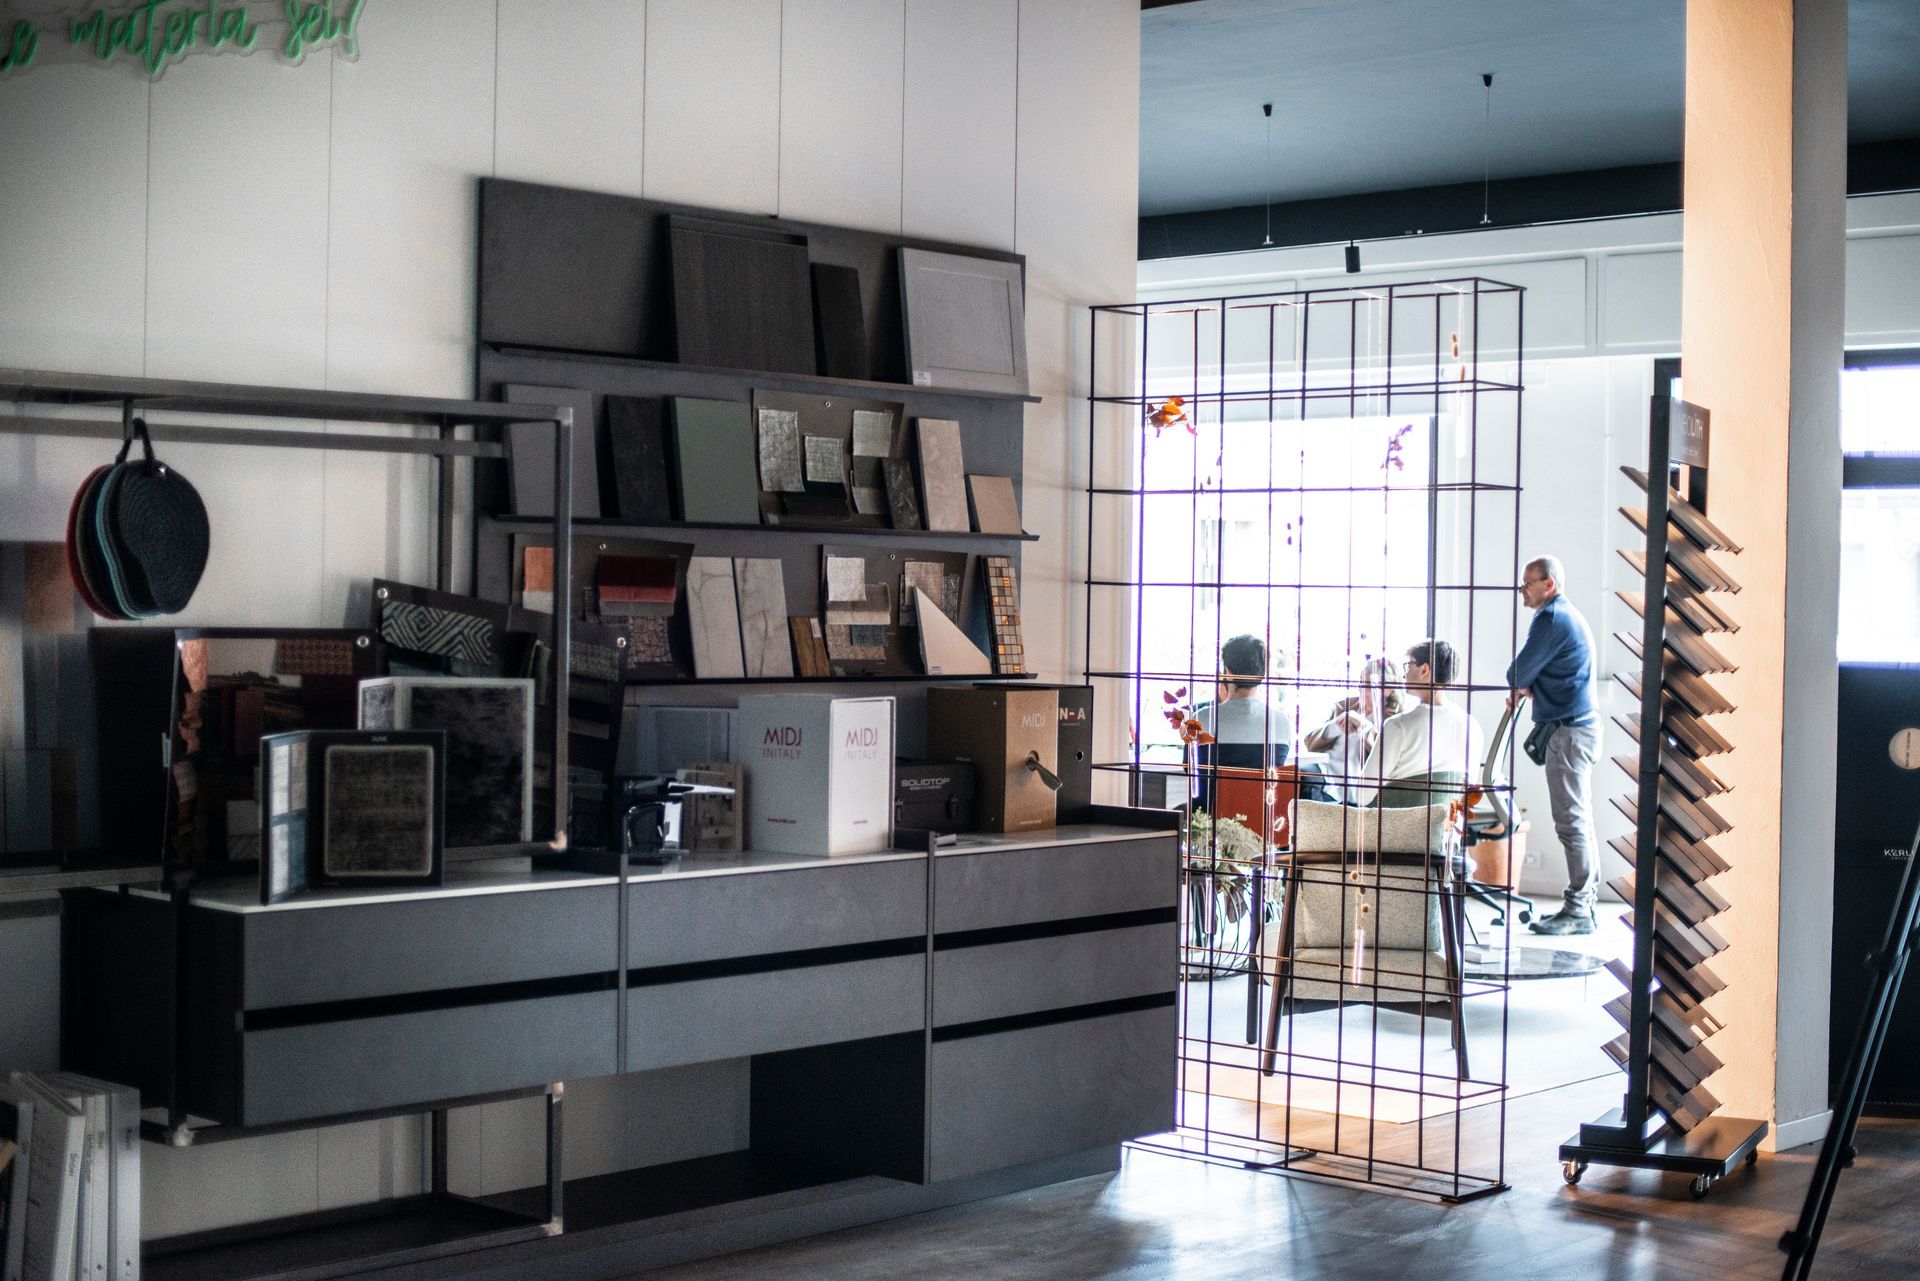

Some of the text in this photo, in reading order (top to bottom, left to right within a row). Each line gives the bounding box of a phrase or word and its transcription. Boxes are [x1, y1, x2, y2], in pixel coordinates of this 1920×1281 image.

[1021, 711, 1047, 728] MIDJ
[763, 727, 802, 746] MIDJ
[845, 728, 878, 747] MIDJ
[901, 777, 951, 787] SOLIDTOP
